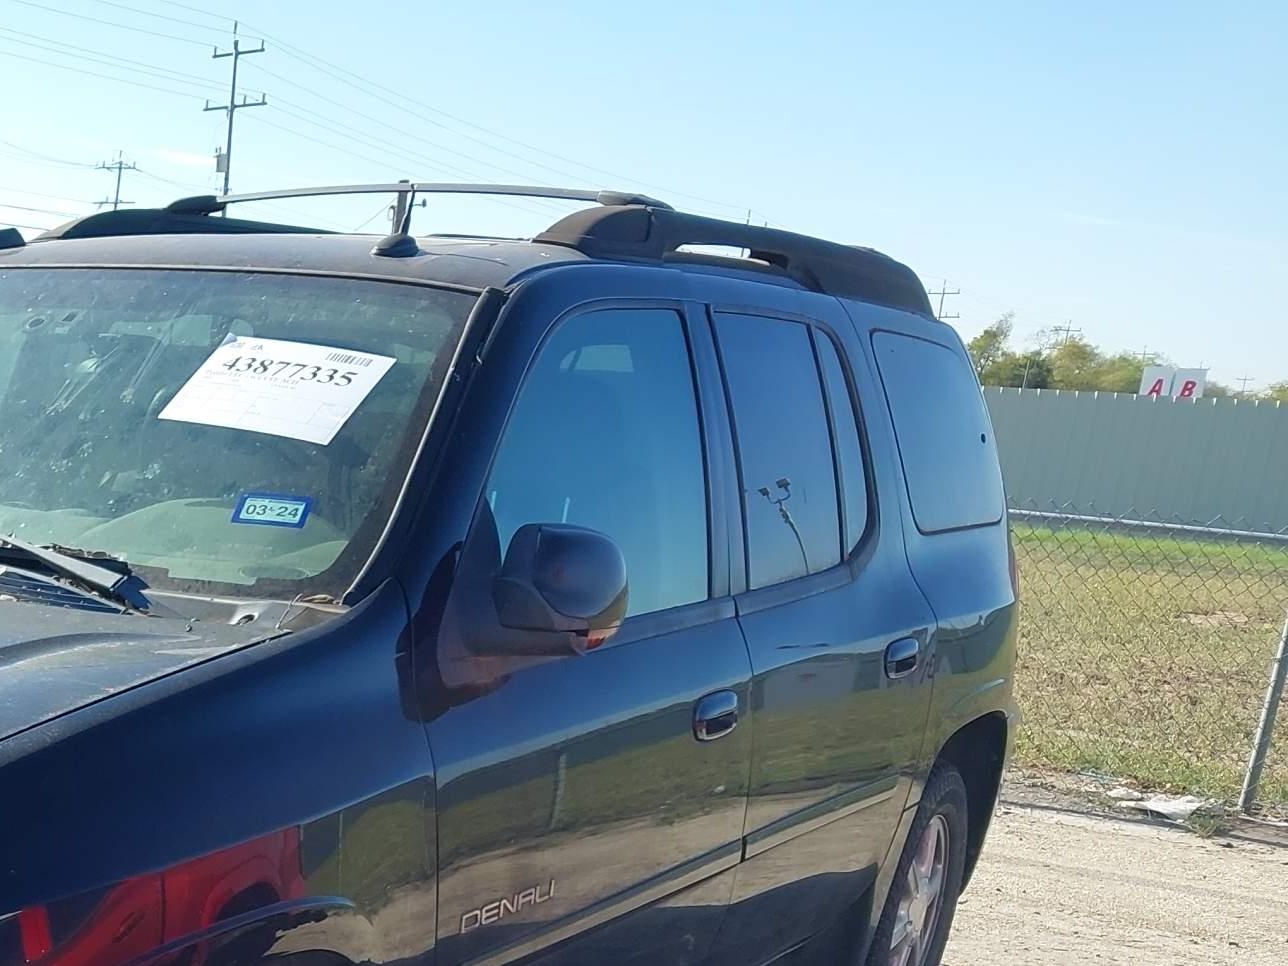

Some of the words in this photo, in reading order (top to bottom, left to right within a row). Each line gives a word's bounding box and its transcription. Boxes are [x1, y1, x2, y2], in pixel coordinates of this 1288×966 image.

[223, 355, 359, 387] 43877335
[1147, 378, 1164, 397] A
[1179, 380, 1197, 398] B
[460, 878, 555, 934] DENALI
